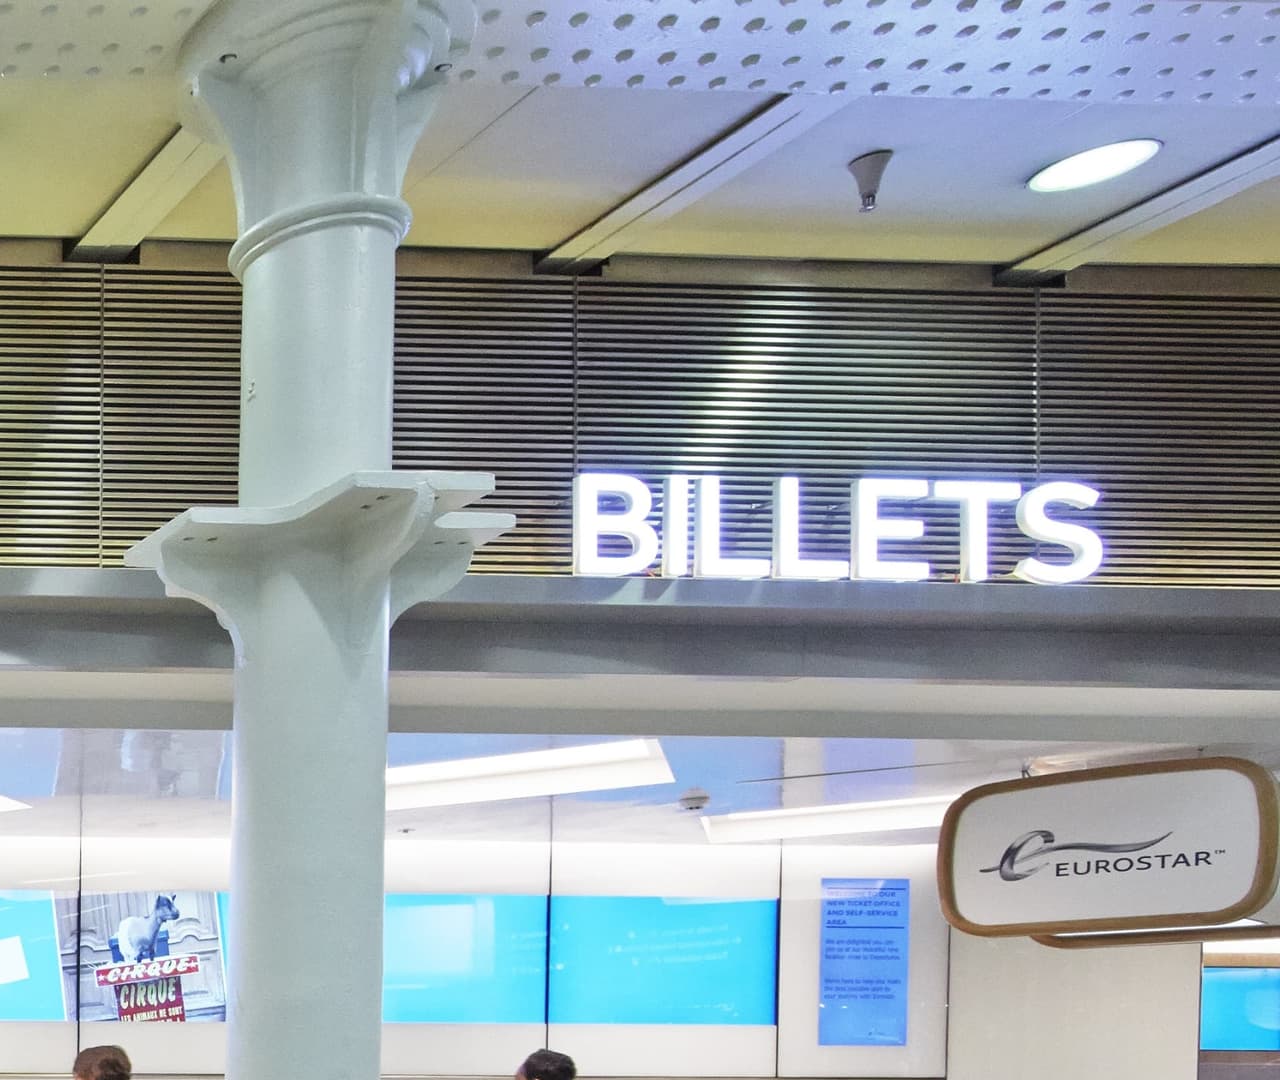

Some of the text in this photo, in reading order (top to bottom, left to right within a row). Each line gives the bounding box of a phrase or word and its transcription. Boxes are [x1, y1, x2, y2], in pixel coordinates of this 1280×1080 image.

[572, 472, 1105, 585] BILLETS
[107, 957, 190, 983] CIRQUE
[119, 977, 177, 1010] CIRQUE
